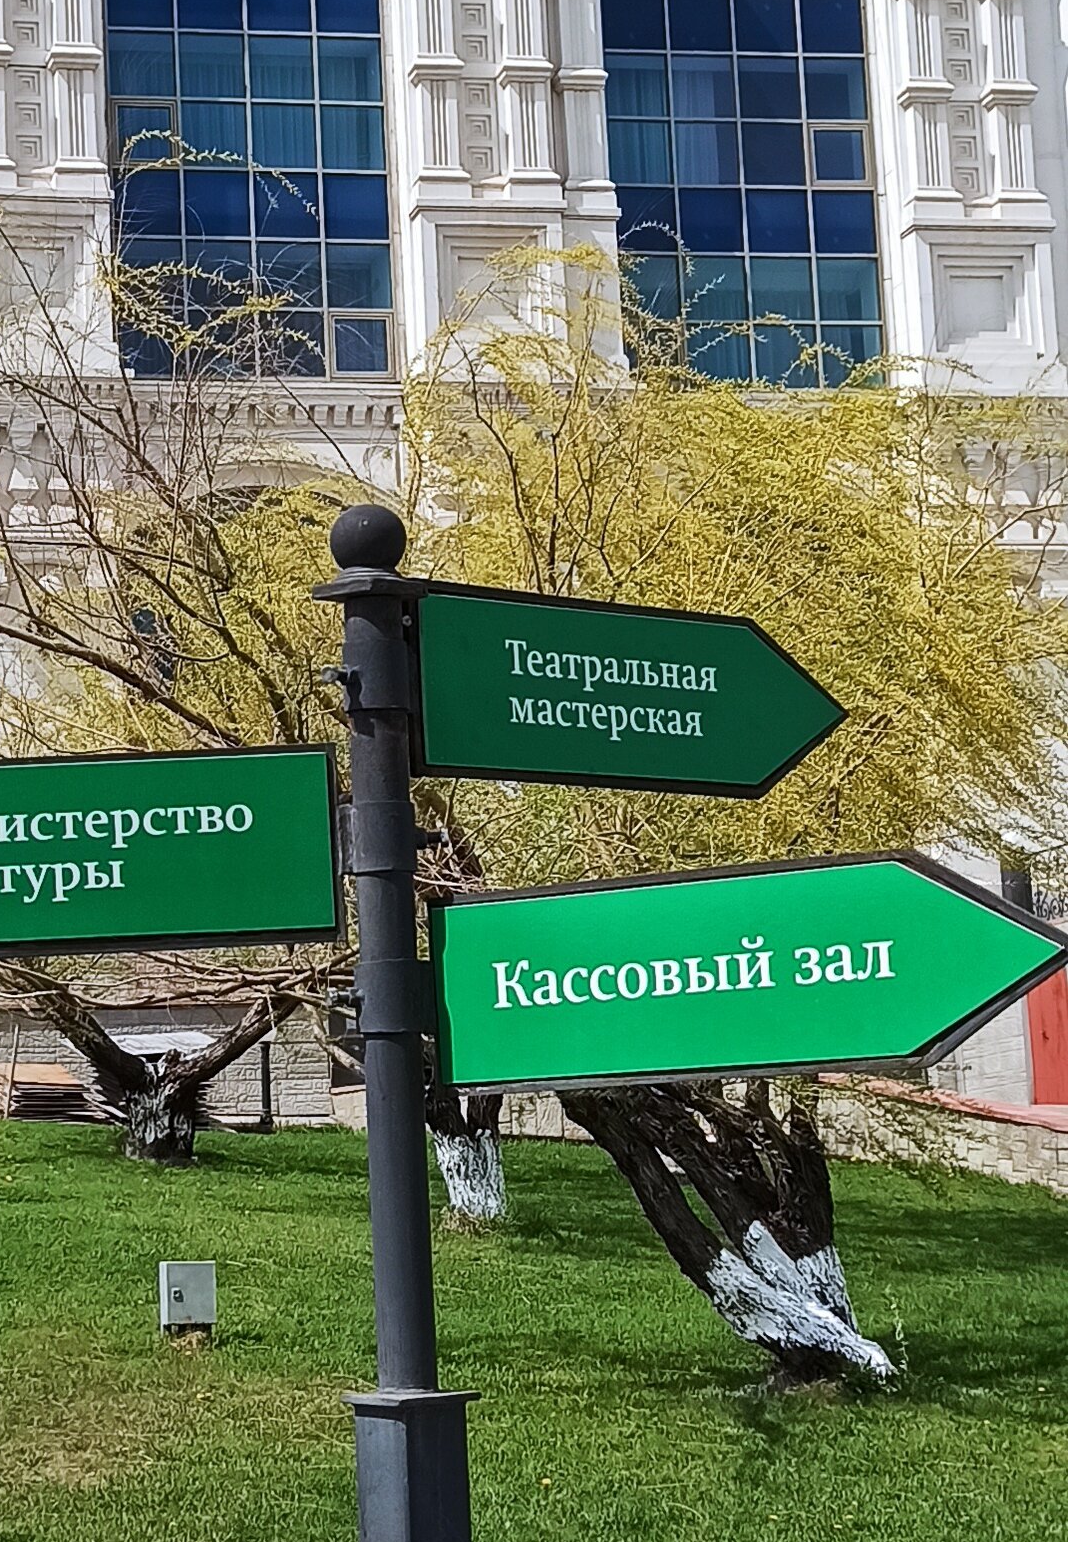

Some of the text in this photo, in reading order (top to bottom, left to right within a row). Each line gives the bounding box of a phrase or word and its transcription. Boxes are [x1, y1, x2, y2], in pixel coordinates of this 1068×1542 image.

[505, 639, 718, 692] Театральная
[508, 696, 704, 741] мастерская
[492, 936, 895, 1008] Кассовый зал
